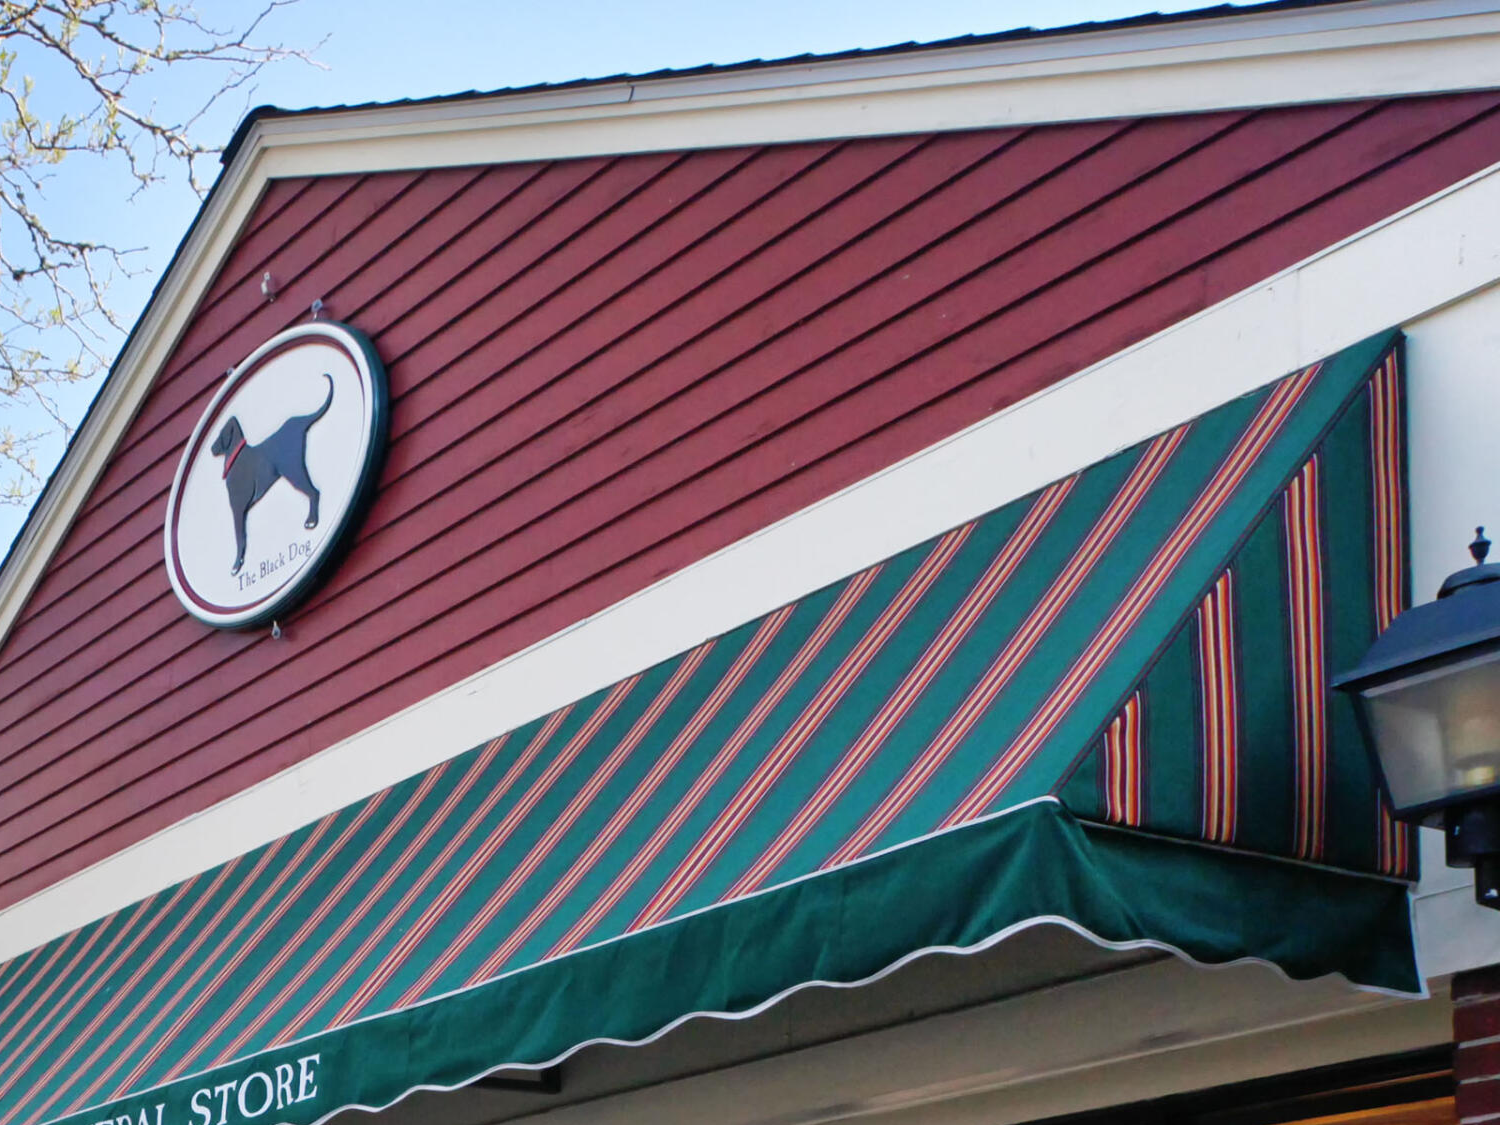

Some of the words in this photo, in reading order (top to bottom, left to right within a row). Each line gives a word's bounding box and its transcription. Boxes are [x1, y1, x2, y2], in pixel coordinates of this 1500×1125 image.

[238, 572, 256, 591] The
[260, 552, 285, 578] Black
[288, 540, 312, 561] Dog
